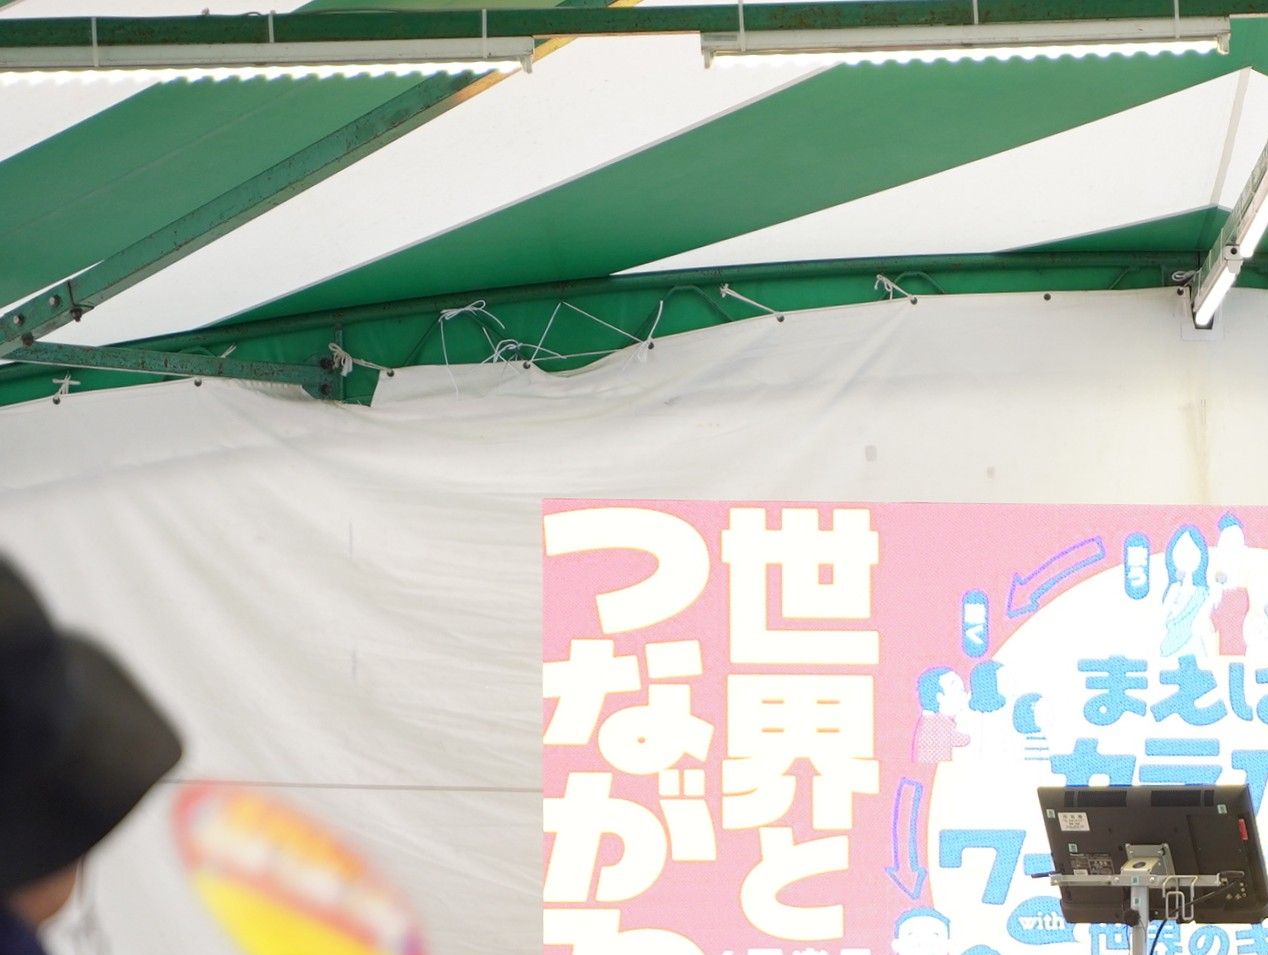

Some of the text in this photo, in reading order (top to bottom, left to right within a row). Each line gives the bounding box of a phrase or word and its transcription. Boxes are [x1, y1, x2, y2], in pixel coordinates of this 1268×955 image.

[721, 508, 880, 942] 世界と
[1018, 911, 1067, 932] with
